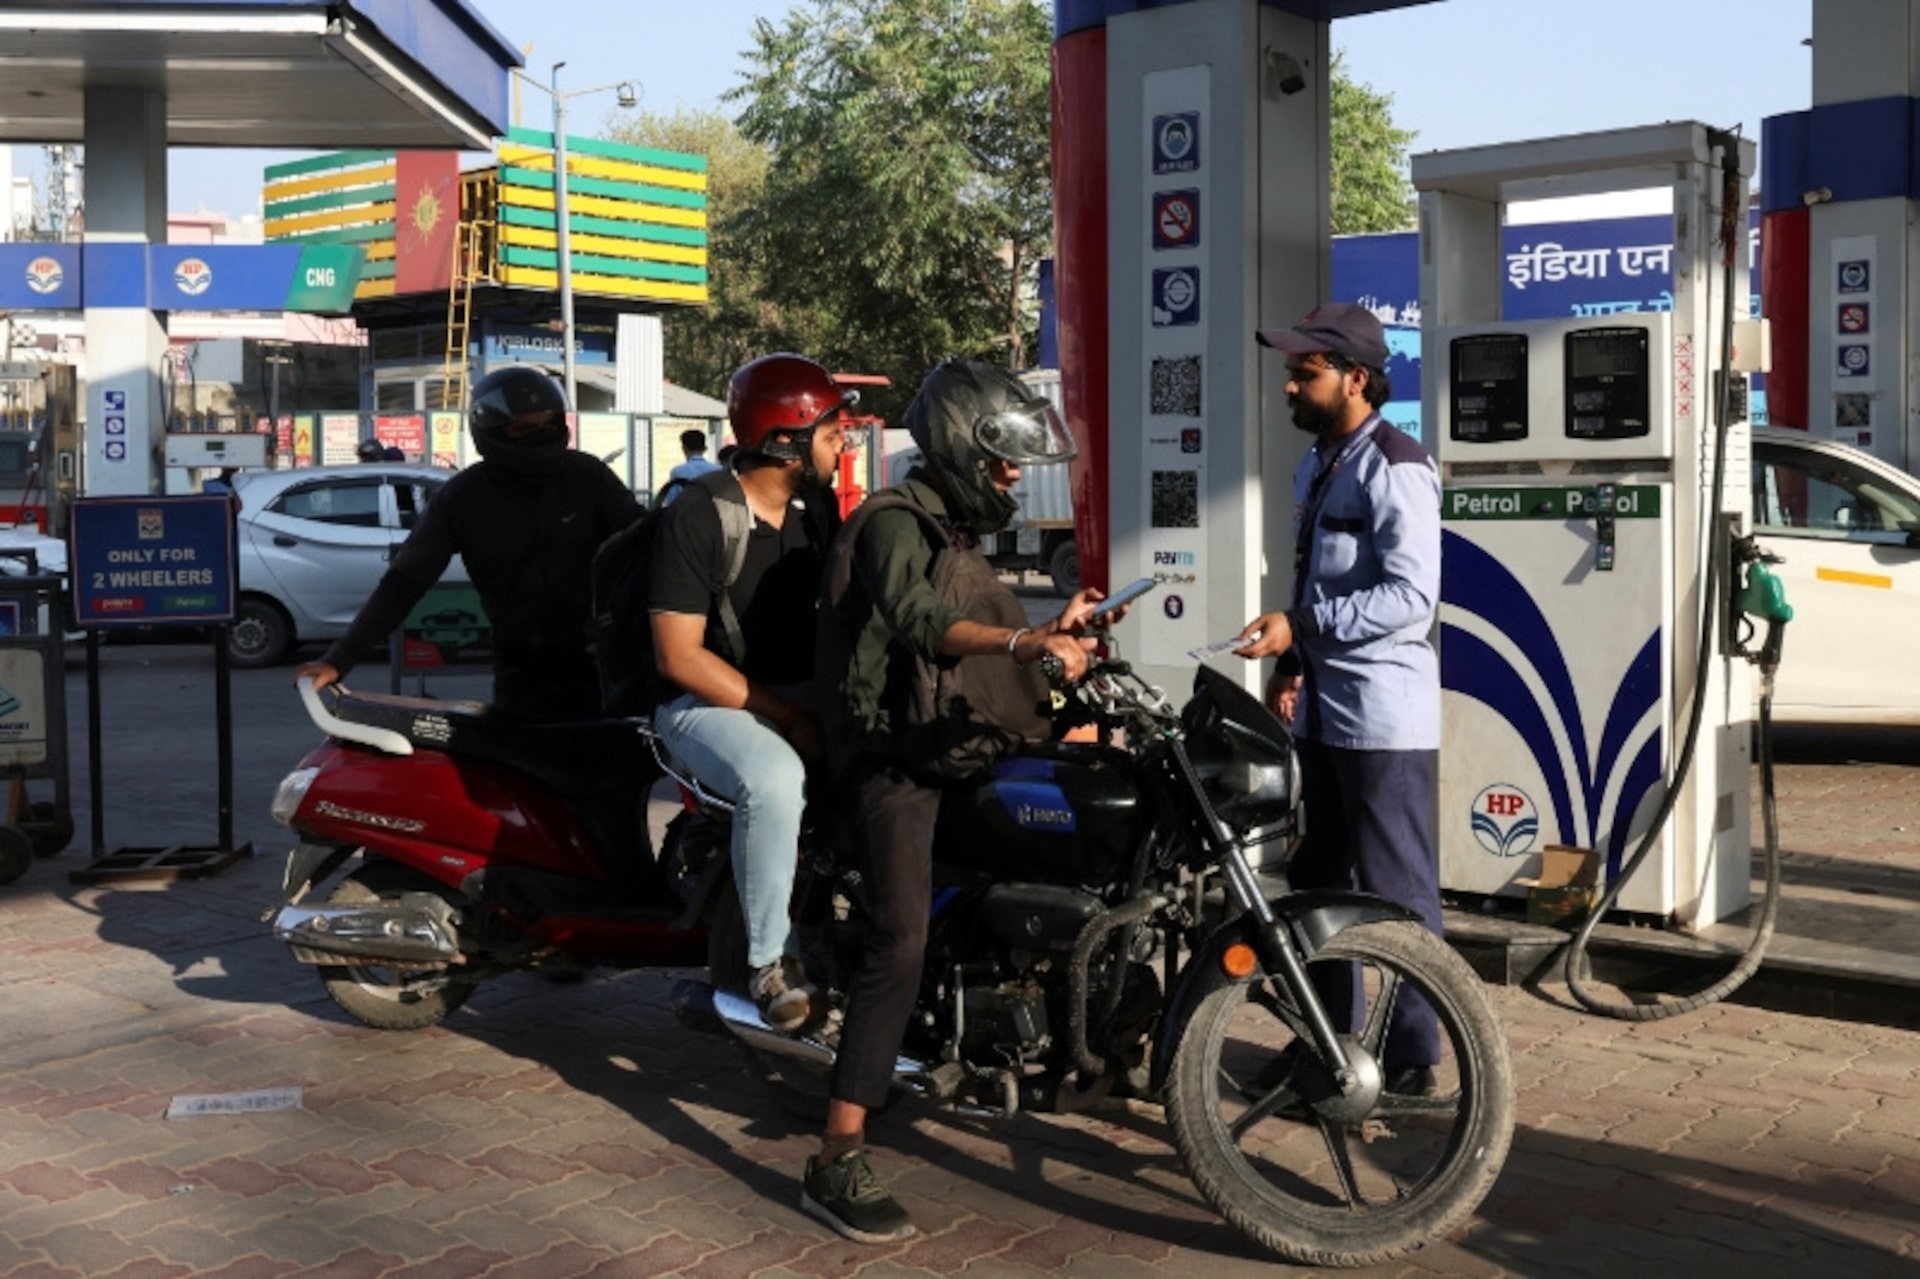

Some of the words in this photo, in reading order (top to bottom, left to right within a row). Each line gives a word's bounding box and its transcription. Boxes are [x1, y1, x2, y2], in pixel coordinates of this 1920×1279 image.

[1506, 243, 1611, 289] इंडिया
[1617, 244, 1673, 277] एन
[306, 268, 336, 287] CNG
[498, 334, 585, 353] KIRLOSKR
[1453, 492, 1521, 514] Petrol
[1566, 491, 1638, 513] Peol
[108, 551, 154, 563] ONLY
[160, 548, 196, 561] FOR
[93, 572, 105, 589] 2
[109, 569, 213, 588] WHEELERS
[1486, 793, 1525, 816] HP
